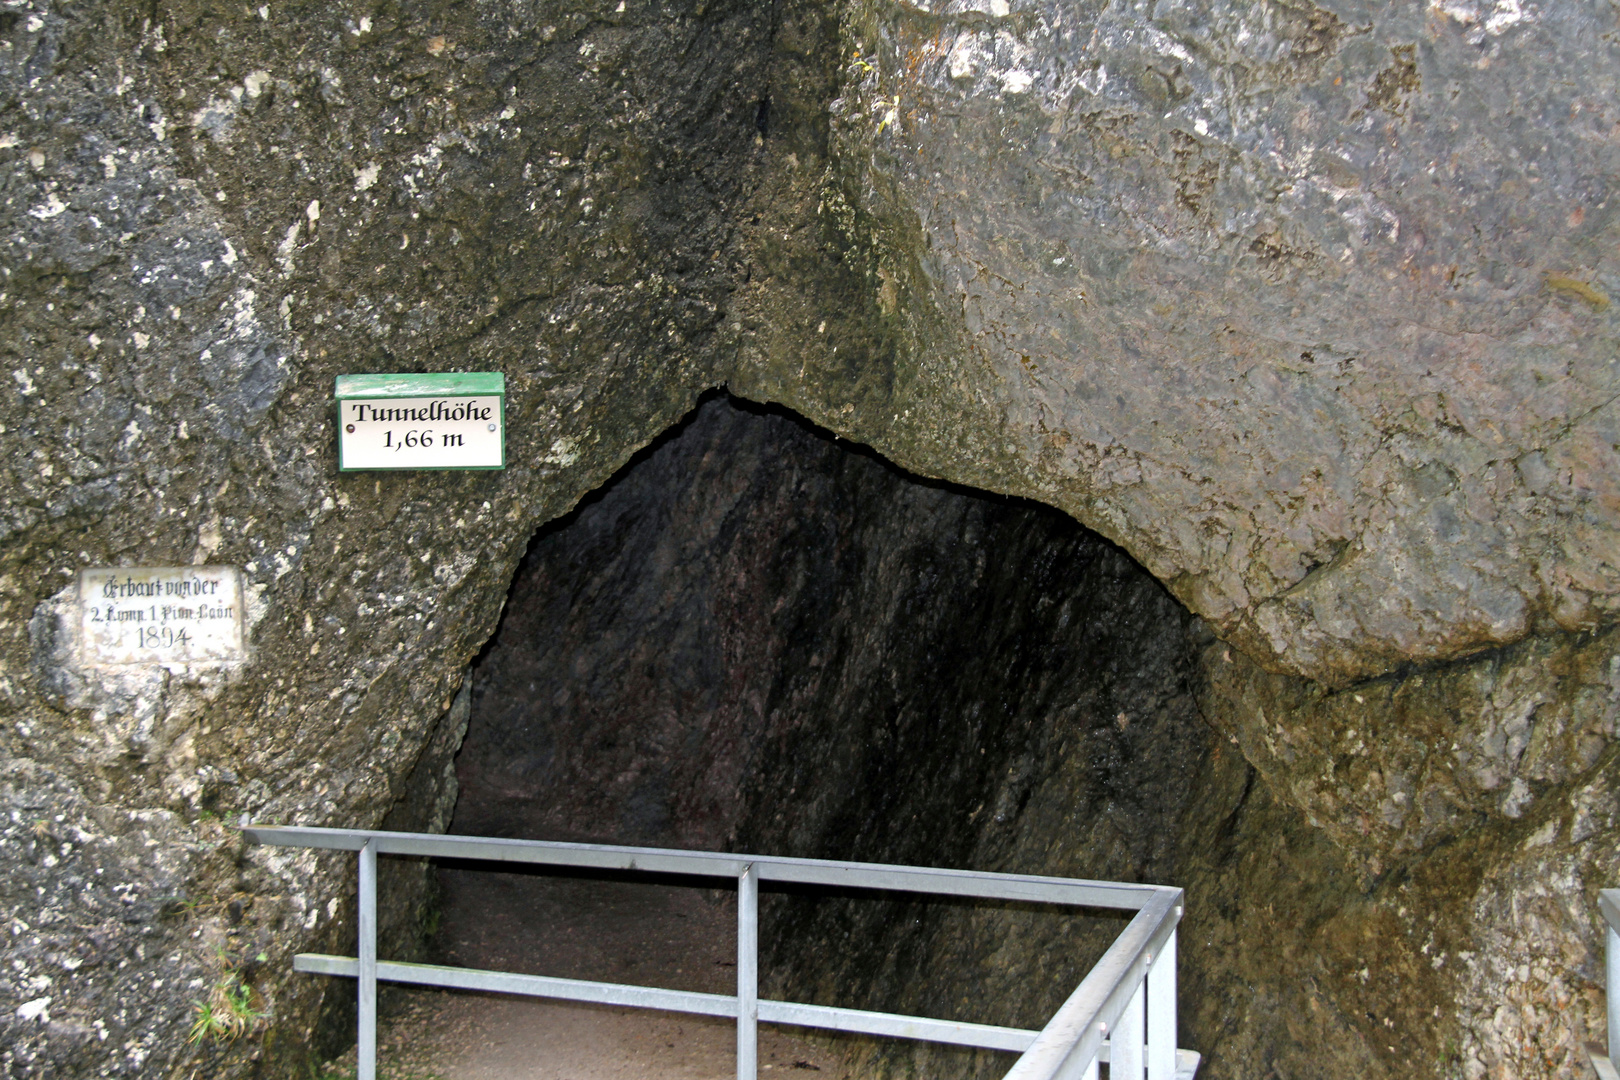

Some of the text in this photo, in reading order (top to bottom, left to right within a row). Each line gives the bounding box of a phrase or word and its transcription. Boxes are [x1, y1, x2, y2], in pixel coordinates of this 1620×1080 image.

[352, 400, 493, 422] Tunnelhöhe
[383, 429, 465, 452] 1,66 m
[103, 575, 220, 598] Erbaut von der
[91, 607, 104, 622] 2.
